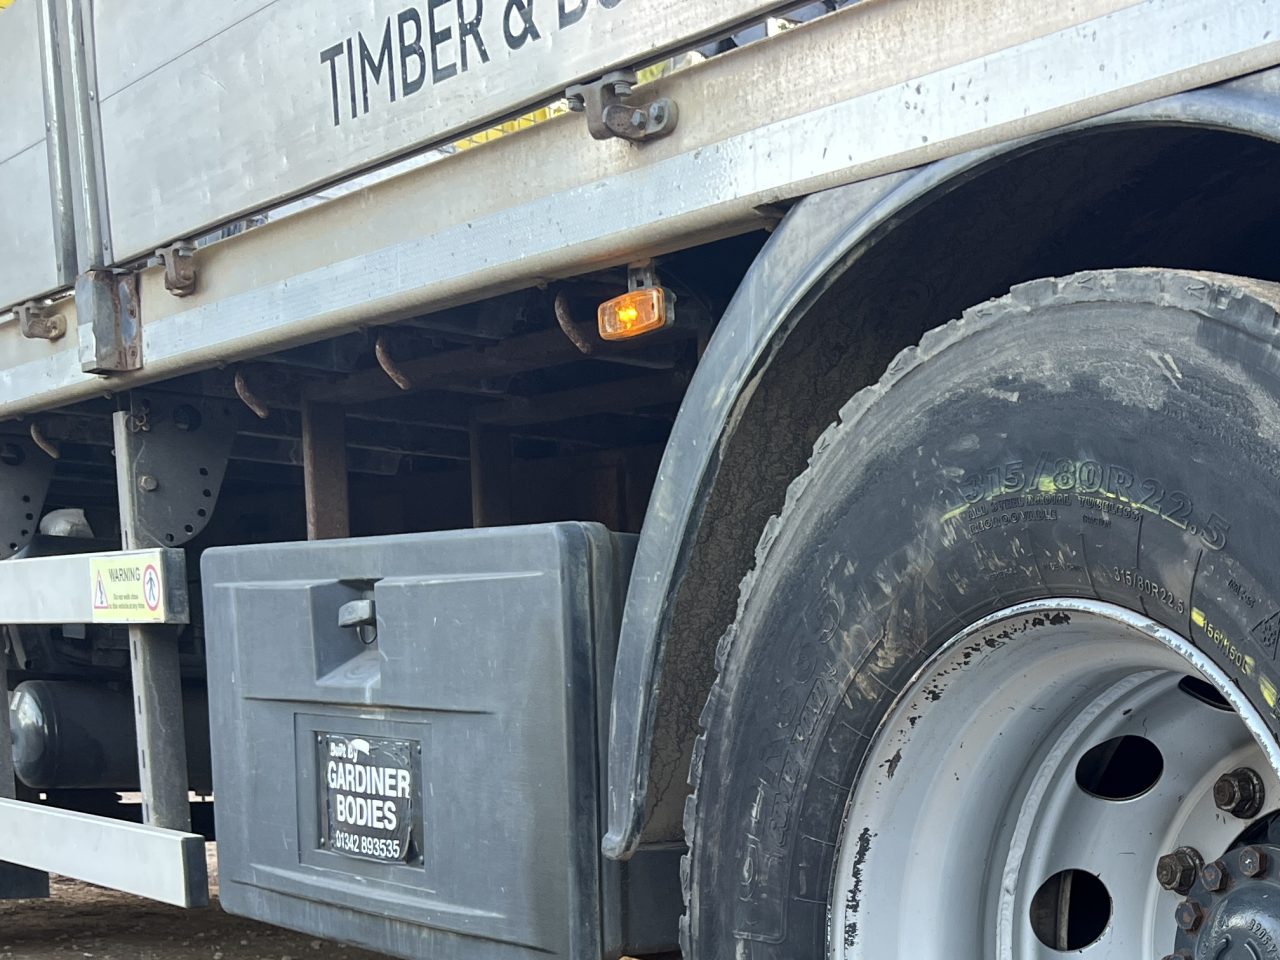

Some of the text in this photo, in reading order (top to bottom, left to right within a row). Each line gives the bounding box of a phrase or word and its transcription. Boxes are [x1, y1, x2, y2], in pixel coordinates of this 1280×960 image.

[320, 0, 541, 126] TIMBER &
[962, 451, 1231, 551] 315/80R22.5
[108, 567, 141, 582] WARNING
[1113, 566, 1186, 614] 315/80R22.5
[327, 760, 411, 799] GARDINER
[336, 794, 397, 831] BODIES
[336, 830, 401, 859] 01342 893535
